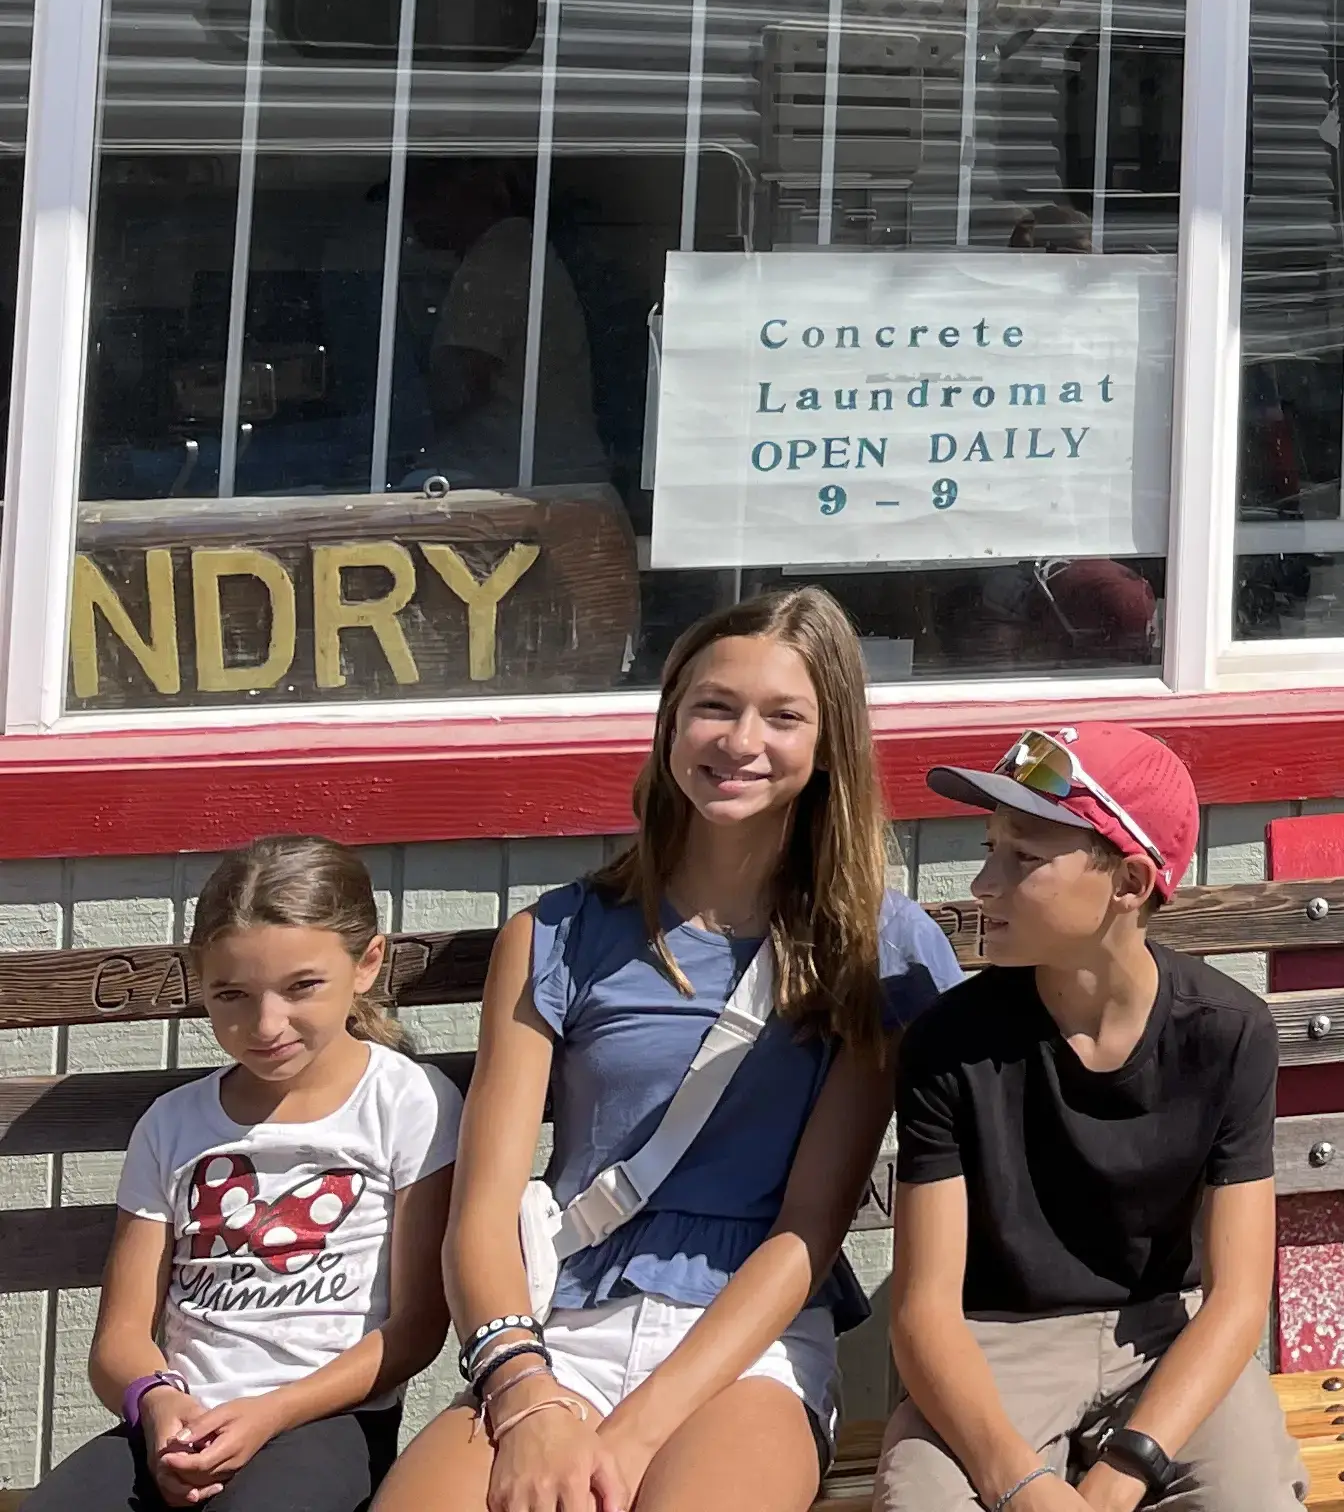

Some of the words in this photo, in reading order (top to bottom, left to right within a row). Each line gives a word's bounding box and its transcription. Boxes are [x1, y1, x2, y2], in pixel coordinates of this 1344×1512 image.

[759, 317, 1024, 350] Concrete
[755, 374, 1116, 414] Laundromat
[751, 436, 889, 472] OPEN
[927, 426, 1091, 465] DAILY
[70, 539, 541, 699] NDRY
